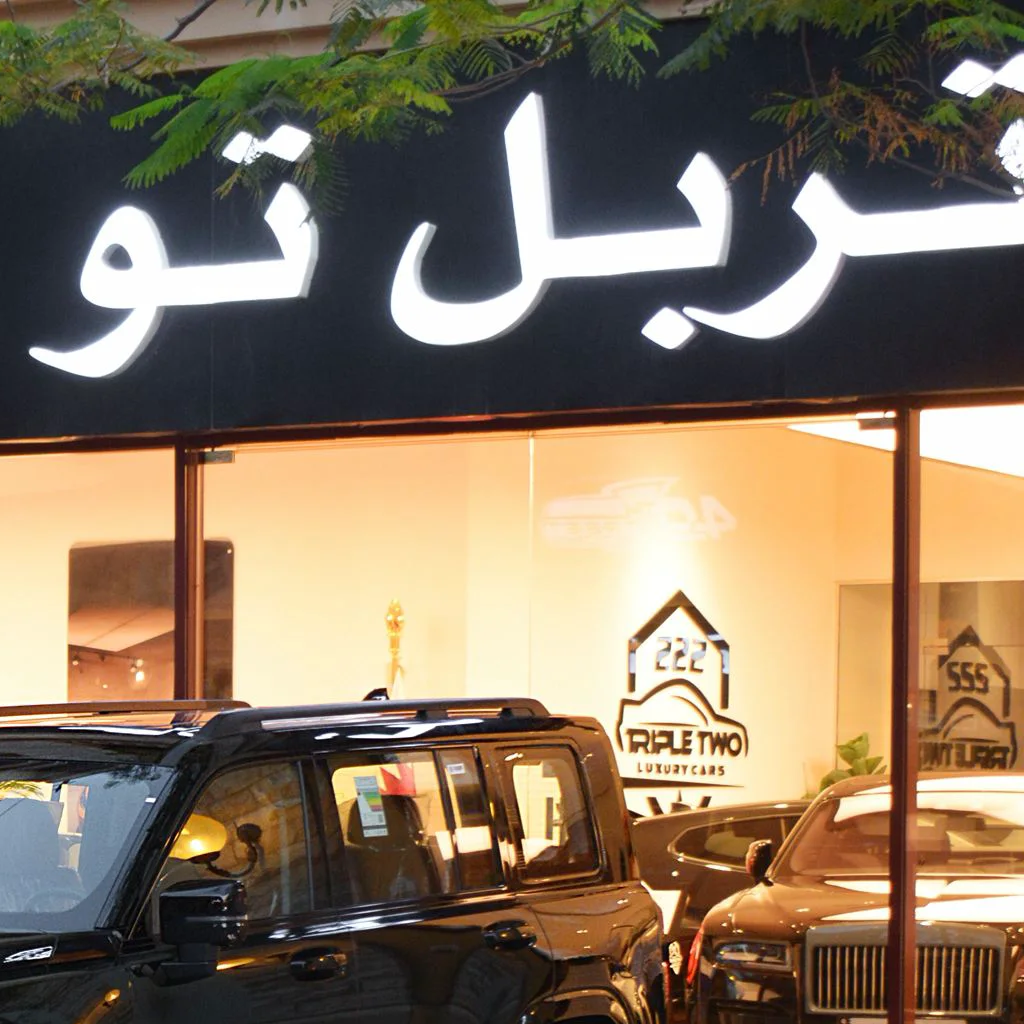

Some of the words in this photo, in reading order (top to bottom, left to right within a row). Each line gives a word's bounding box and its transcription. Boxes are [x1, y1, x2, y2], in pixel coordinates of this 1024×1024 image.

[28, 124, 319, 378] تو
[655, 636, 707, 673] 222
[626, 728, 693, 756] TRIPLE
[696, 730, 743, 757] TWO
